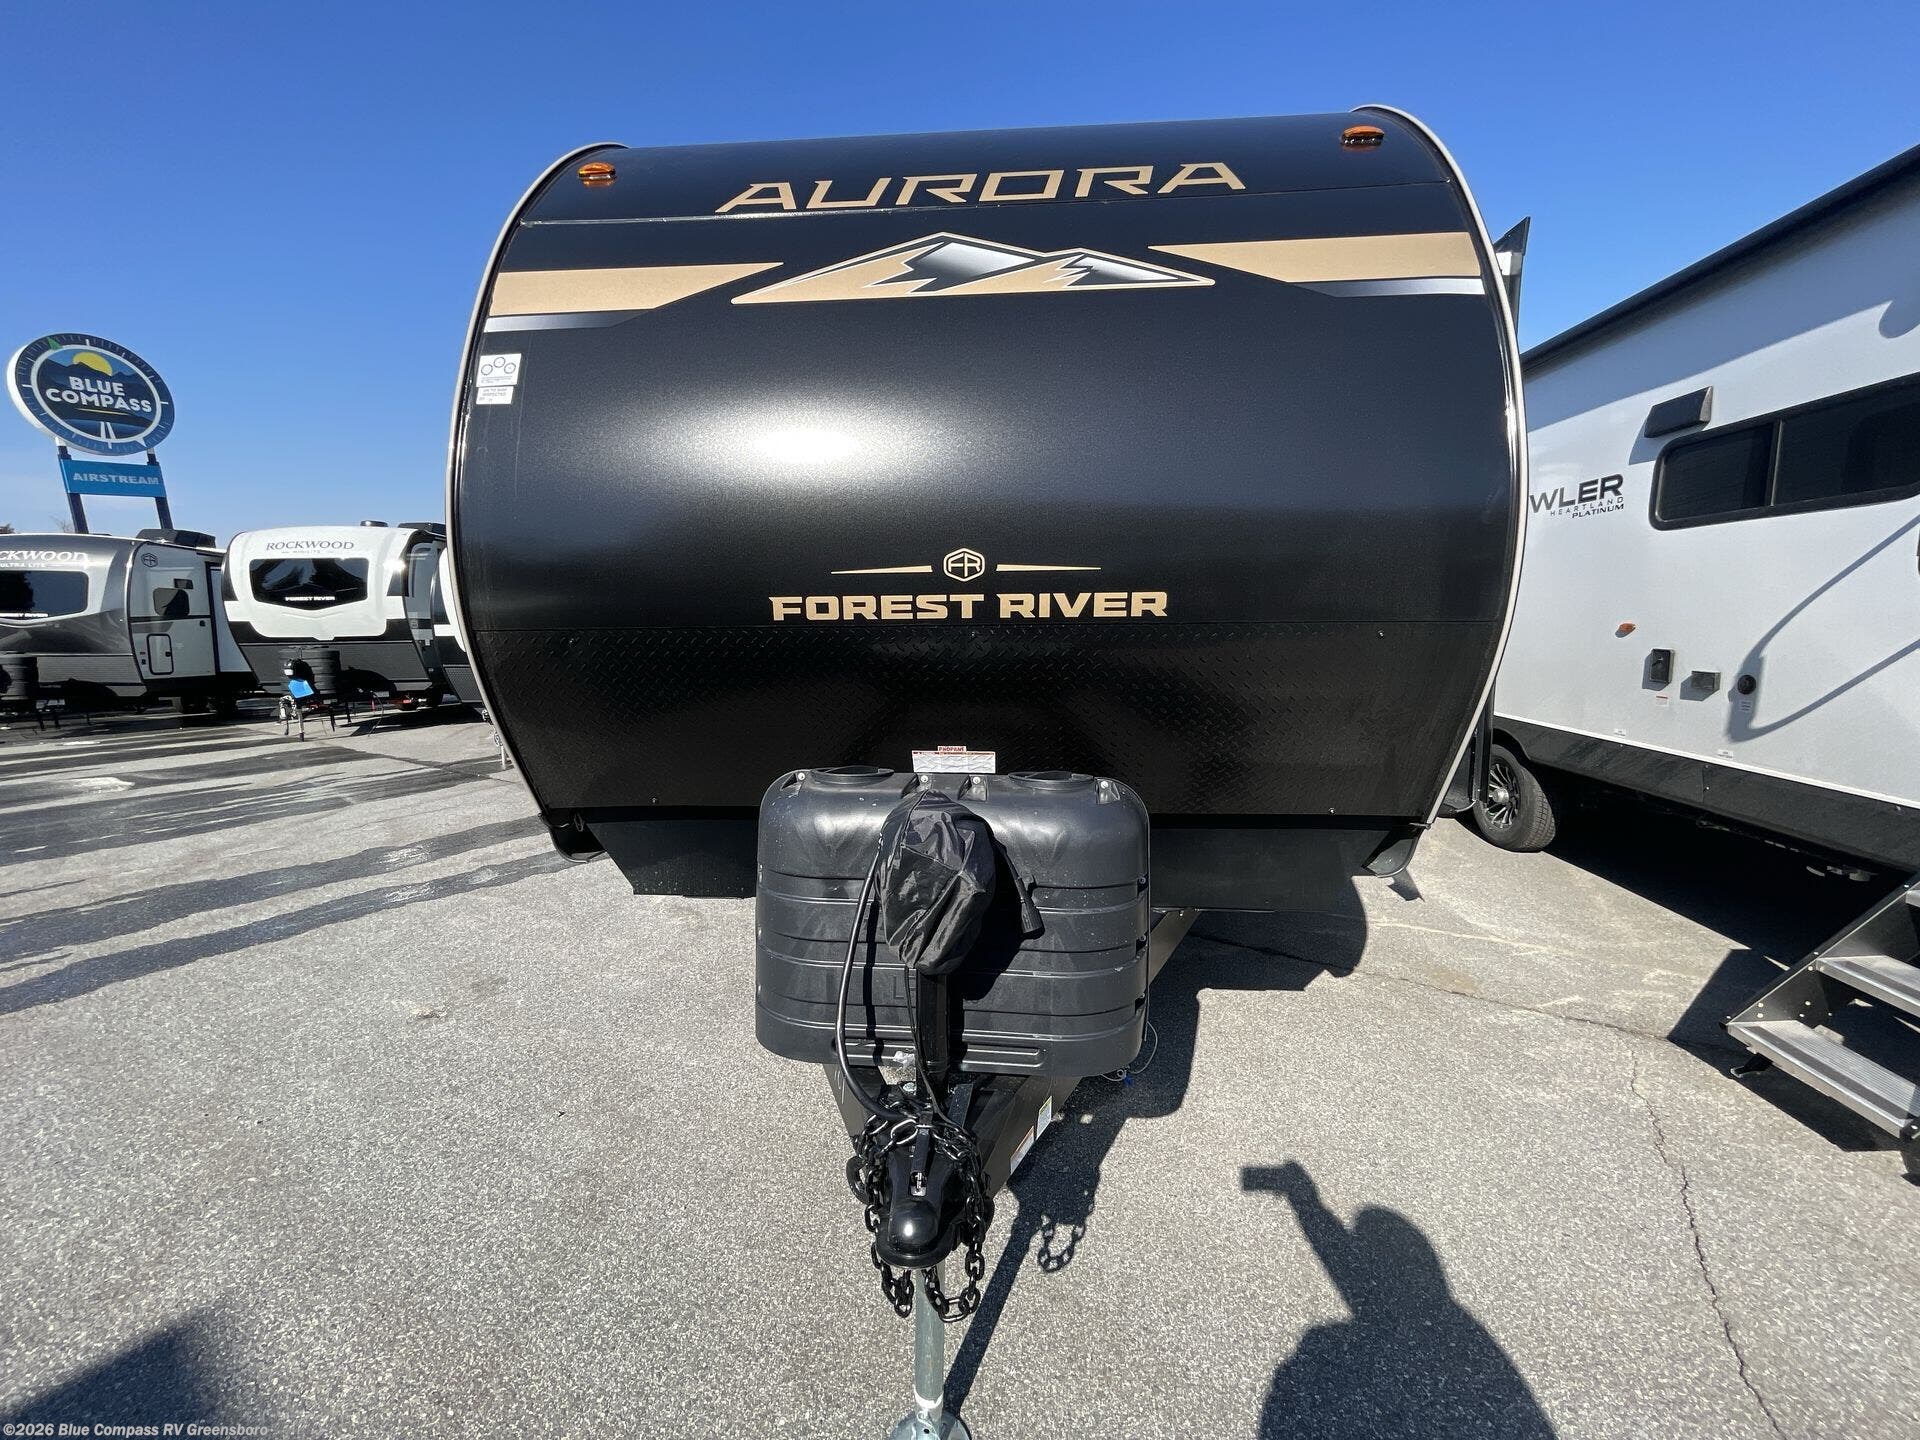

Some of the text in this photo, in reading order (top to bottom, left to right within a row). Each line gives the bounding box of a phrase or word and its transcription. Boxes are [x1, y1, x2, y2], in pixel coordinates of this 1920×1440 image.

[715, 162, 1246, 213] AURORA
[69, 376, 125, 396] BLUE
[46, 388, 152, 412] COMPASS
[73, 472, 160, 485] AIRSTREAM
[1529, 474, 1624, 513] WLER
[1550, 496, 1624, 516] HEARTLAND
[1572, 503, 1625, 518] PLATINUM
[266, 540, 355, 551] ROCKWOOD
[769, 591, 1169, 621] FOREST RIVER
